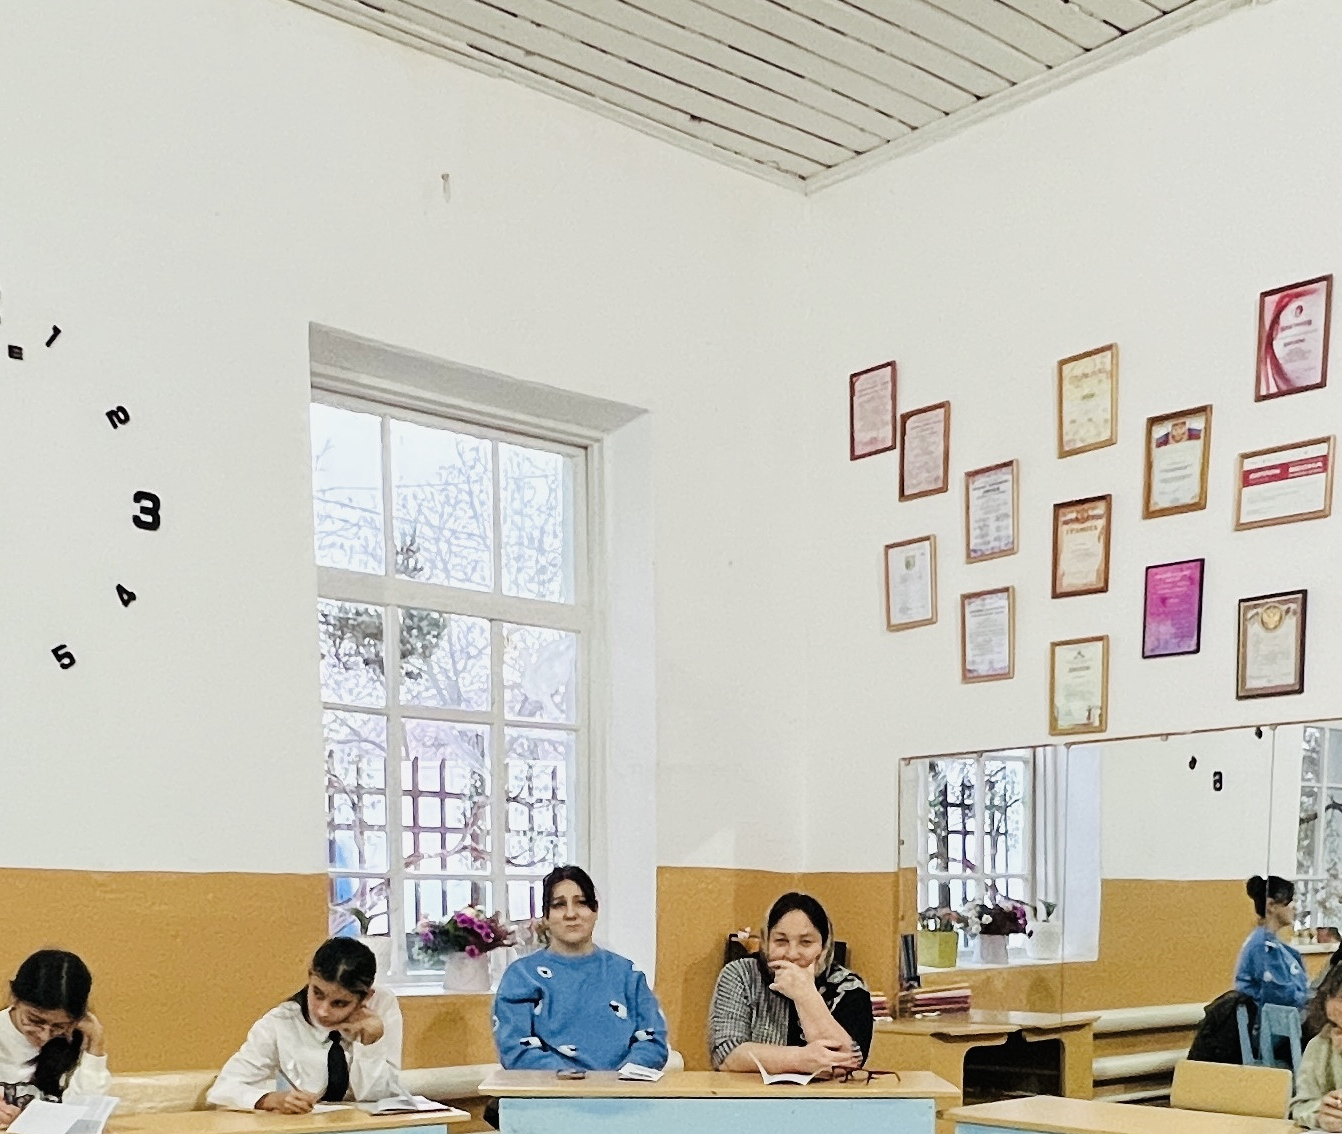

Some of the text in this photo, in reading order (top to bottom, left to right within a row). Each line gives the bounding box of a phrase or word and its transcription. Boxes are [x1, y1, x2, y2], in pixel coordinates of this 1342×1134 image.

[45, 324, 62, 348] 1
[105, 405, 131, 430] 2
[132, 490, 161, 532] 3
[115, 583, 137, 608] 4
[50, 644, 76, 670] 5
